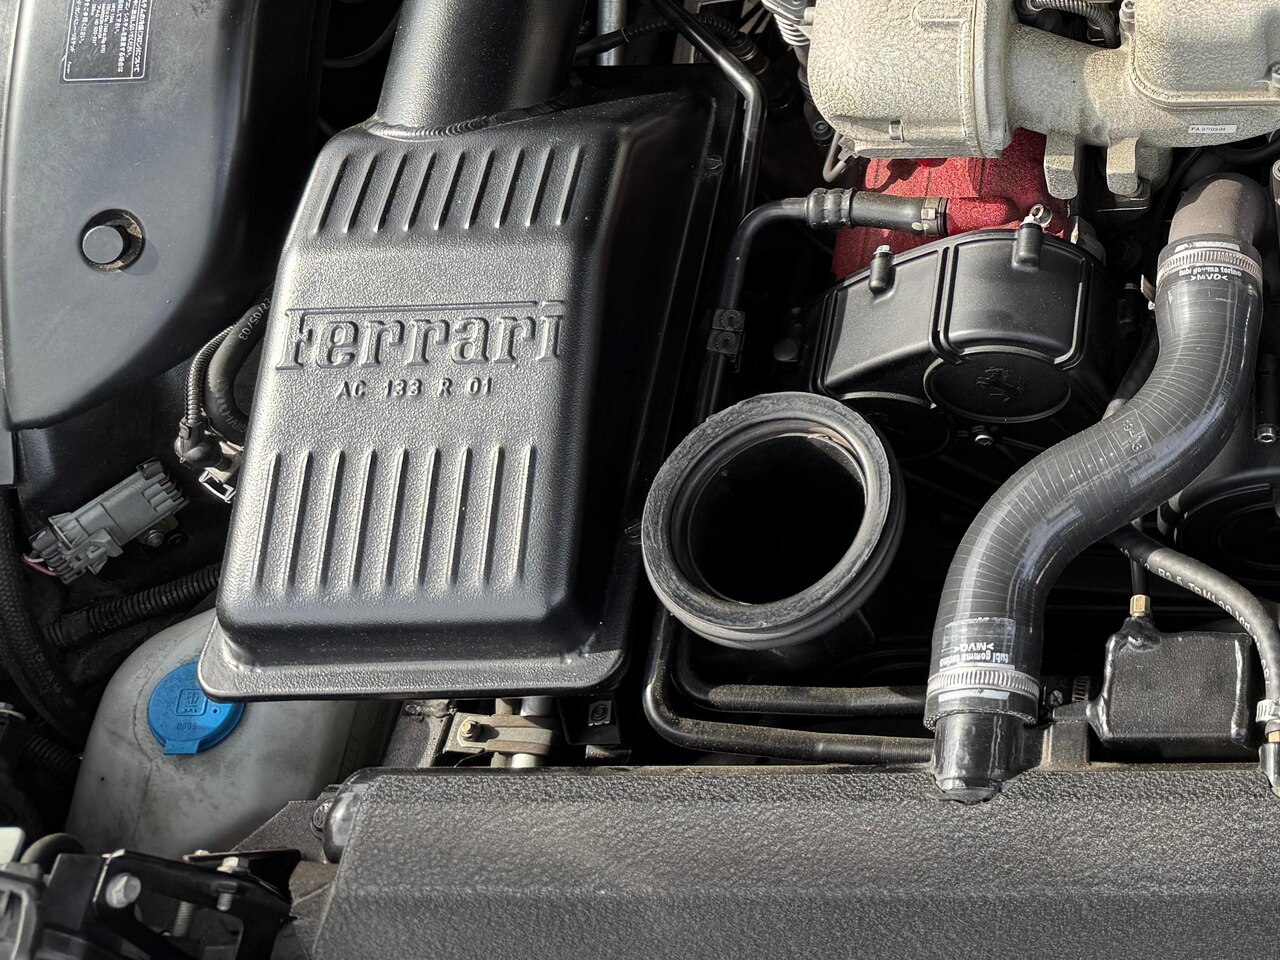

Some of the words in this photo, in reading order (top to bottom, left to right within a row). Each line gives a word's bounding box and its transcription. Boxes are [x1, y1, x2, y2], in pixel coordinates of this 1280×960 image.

[275, 300, 566, 371] Ferrari
[336, 380, 366, 399] AC
[384, 378, 423, 398] 133
[438, 377, 453, 397] R
[468, 376, 493, 397] 01
